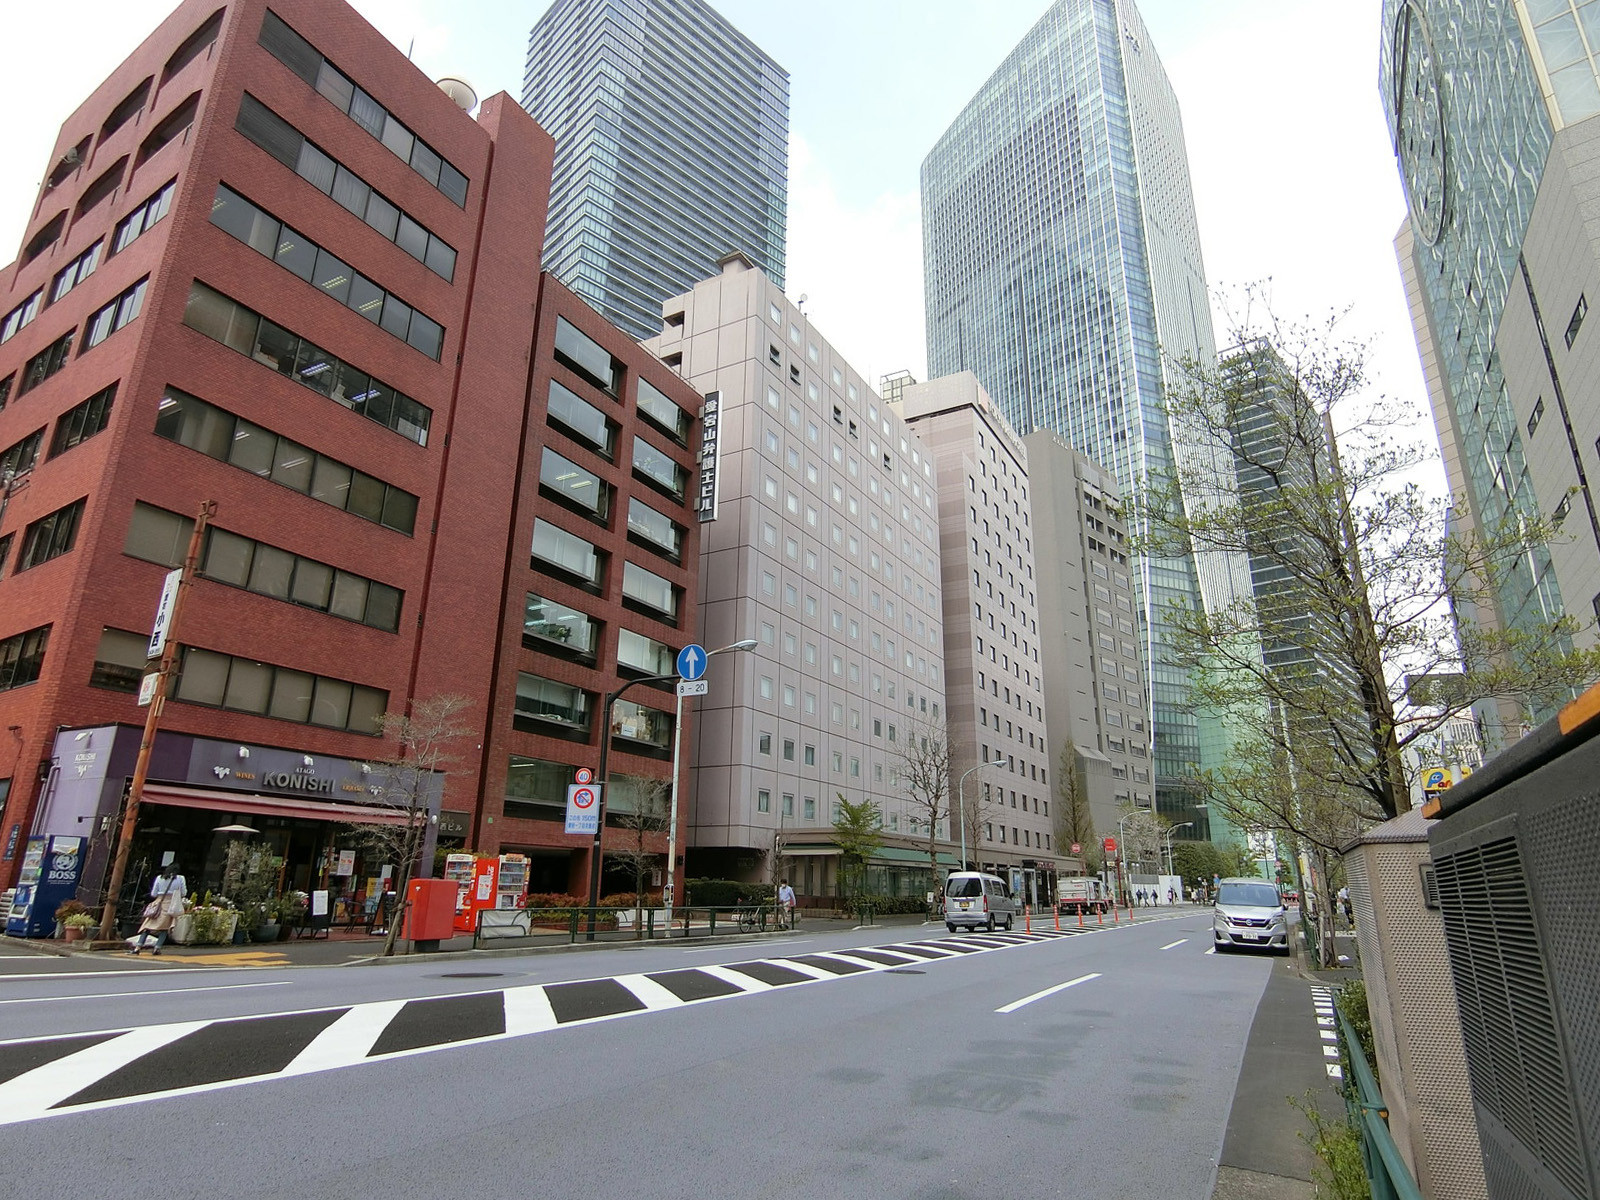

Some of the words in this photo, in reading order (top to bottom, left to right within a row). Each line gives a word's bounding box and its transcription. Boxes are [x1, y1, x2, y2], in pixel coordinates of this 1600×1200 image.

[235, 771, 256, 780] WINES
[295, 767, 315, 775] ATAGO
[263, 771, 336, 793] KONISHI
[48, 870, 77, 880] BOSS
